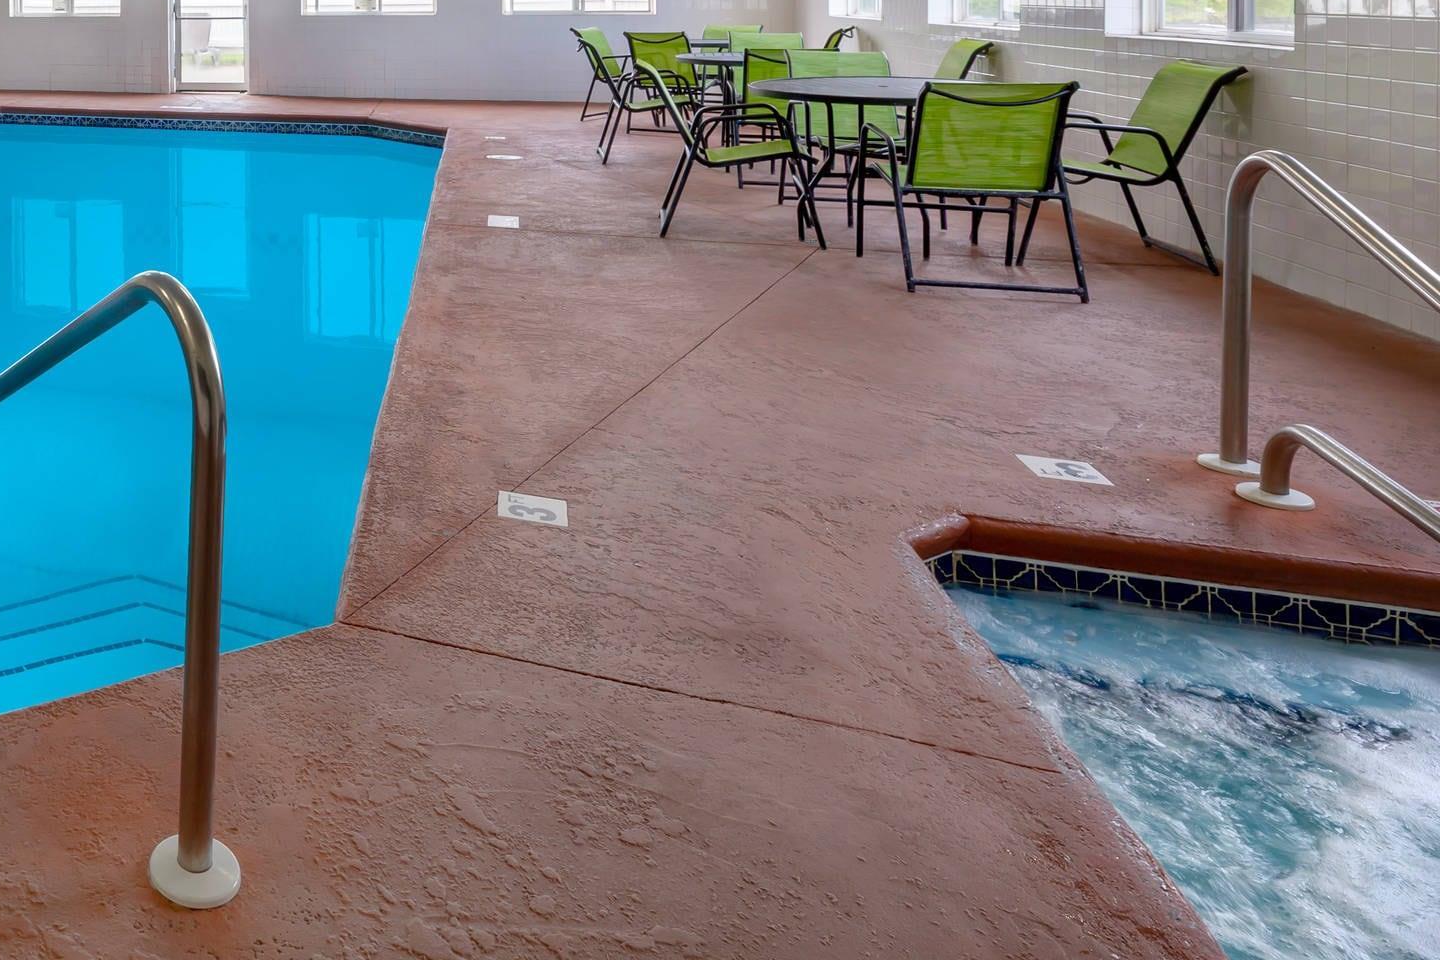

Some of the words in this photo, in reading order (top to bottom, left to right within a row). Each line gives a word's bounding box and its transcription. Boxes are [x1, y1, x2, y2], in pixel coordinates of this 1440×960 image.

[1055, 462, 1100, 480] 3
[508, 494, 525, 504] FT
[508, 504, 558, 521] 3
